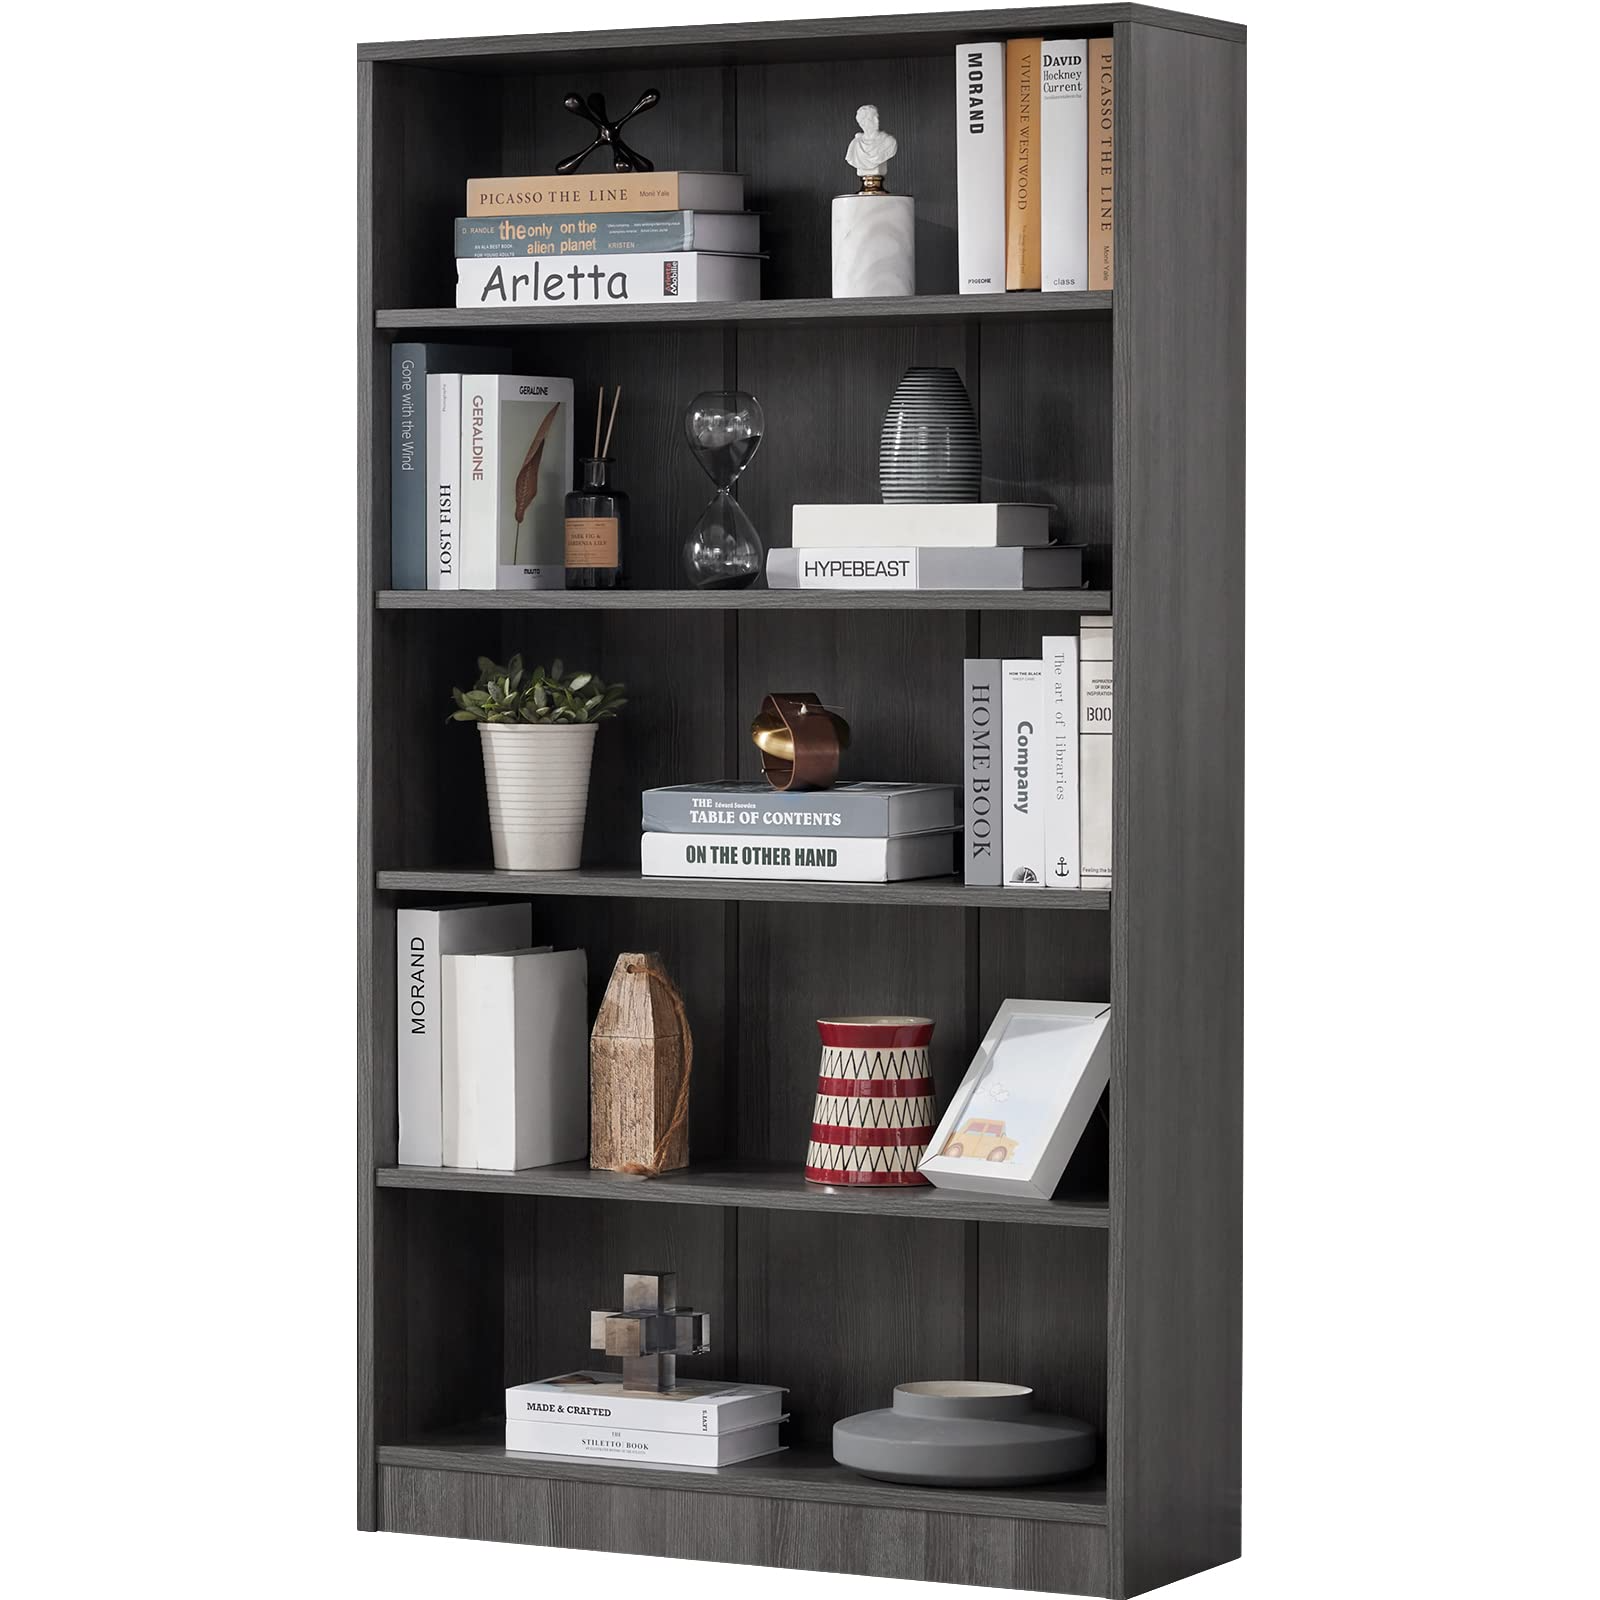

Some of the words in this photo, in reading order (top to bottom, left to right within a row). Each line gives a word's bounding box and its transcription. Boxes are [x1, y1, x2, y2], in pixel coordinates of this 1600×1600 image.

[1043, 69, 1082, 81] Hockney
[967, 52, 984, 134] MORAND
[1020, 54, 1031, 124] VIVIENNE
[1043, 81, 1083, 93] Current
[1101, 54, 1113, 130] PICASSO
[1101, 137, 1112, 176] THE
[1018, 126, 1030, 211] WESTWOOD
[480, 191, 543, 205] PICASSO
[549, 190, 581, 203] THE
[589, 188, 628, 201] LINE
[1101, 186, 1112, 232] LINE
[470, 226, 495, 234] RANDLE
[498, 220, 527, 241] the
[527, 223, 553, 240] only
[560, 223, 576, 235] on
[577, 219, 597, 234] the
[527, 240, 555, 255] alien
[560, 237, 597, 254] planet
[608, 241, 635, 249] KRISTEN
[481, 260, 629, 302] Arletta
[1053, 278, 1075, 286] class
[402, 359, 414, 391] Gone
[519, 385, 549, 396] GERALDINE
[402, 394, 414, 418] with
[402, 419, 414, 439] the
[473, 395, 484, 481] GERALDINE
[402, 440, 414, 471] Wind
[440, 484, 452, 523] FISH
[440, 530, 452, 574] LOST
[804, 560, 910, 577] HYPEBEAST
[1054, 652, 1064, 675] The
[1054, 682, 1064, 705] art
[1055, 711, 1066, 727] of
[1086, 707, 1112, 721] BOO
[971, 684, 990, 770] HOME
[1013, 720, 1034, 815] Company
[1055, 736, 1067, 801] libraries
[692, 798, 713, 808] THE
[689, 810, 735, 824] TABLE
[738, 811, 760, 825] OF
[762, 812, 842, 826] CONTENTS
[972, 778, 991, 858] BOOK
[685, 845, 707, 864] ON
[710, 846, 738, 865] THE
[742, 847, 791, 866] OTHER
[794, 848, 838, 867] HAND
[410, 936, 426, 1035] MORAND
[526, 1402, 556, 1412] MADE
[557, 1405, 565, 1413] &
[566, 1406, 612, 1417] CRAFTED
[581, 1439, 622, 1447] STILETTO
[626, 1442, 649, 1450] BOOK
